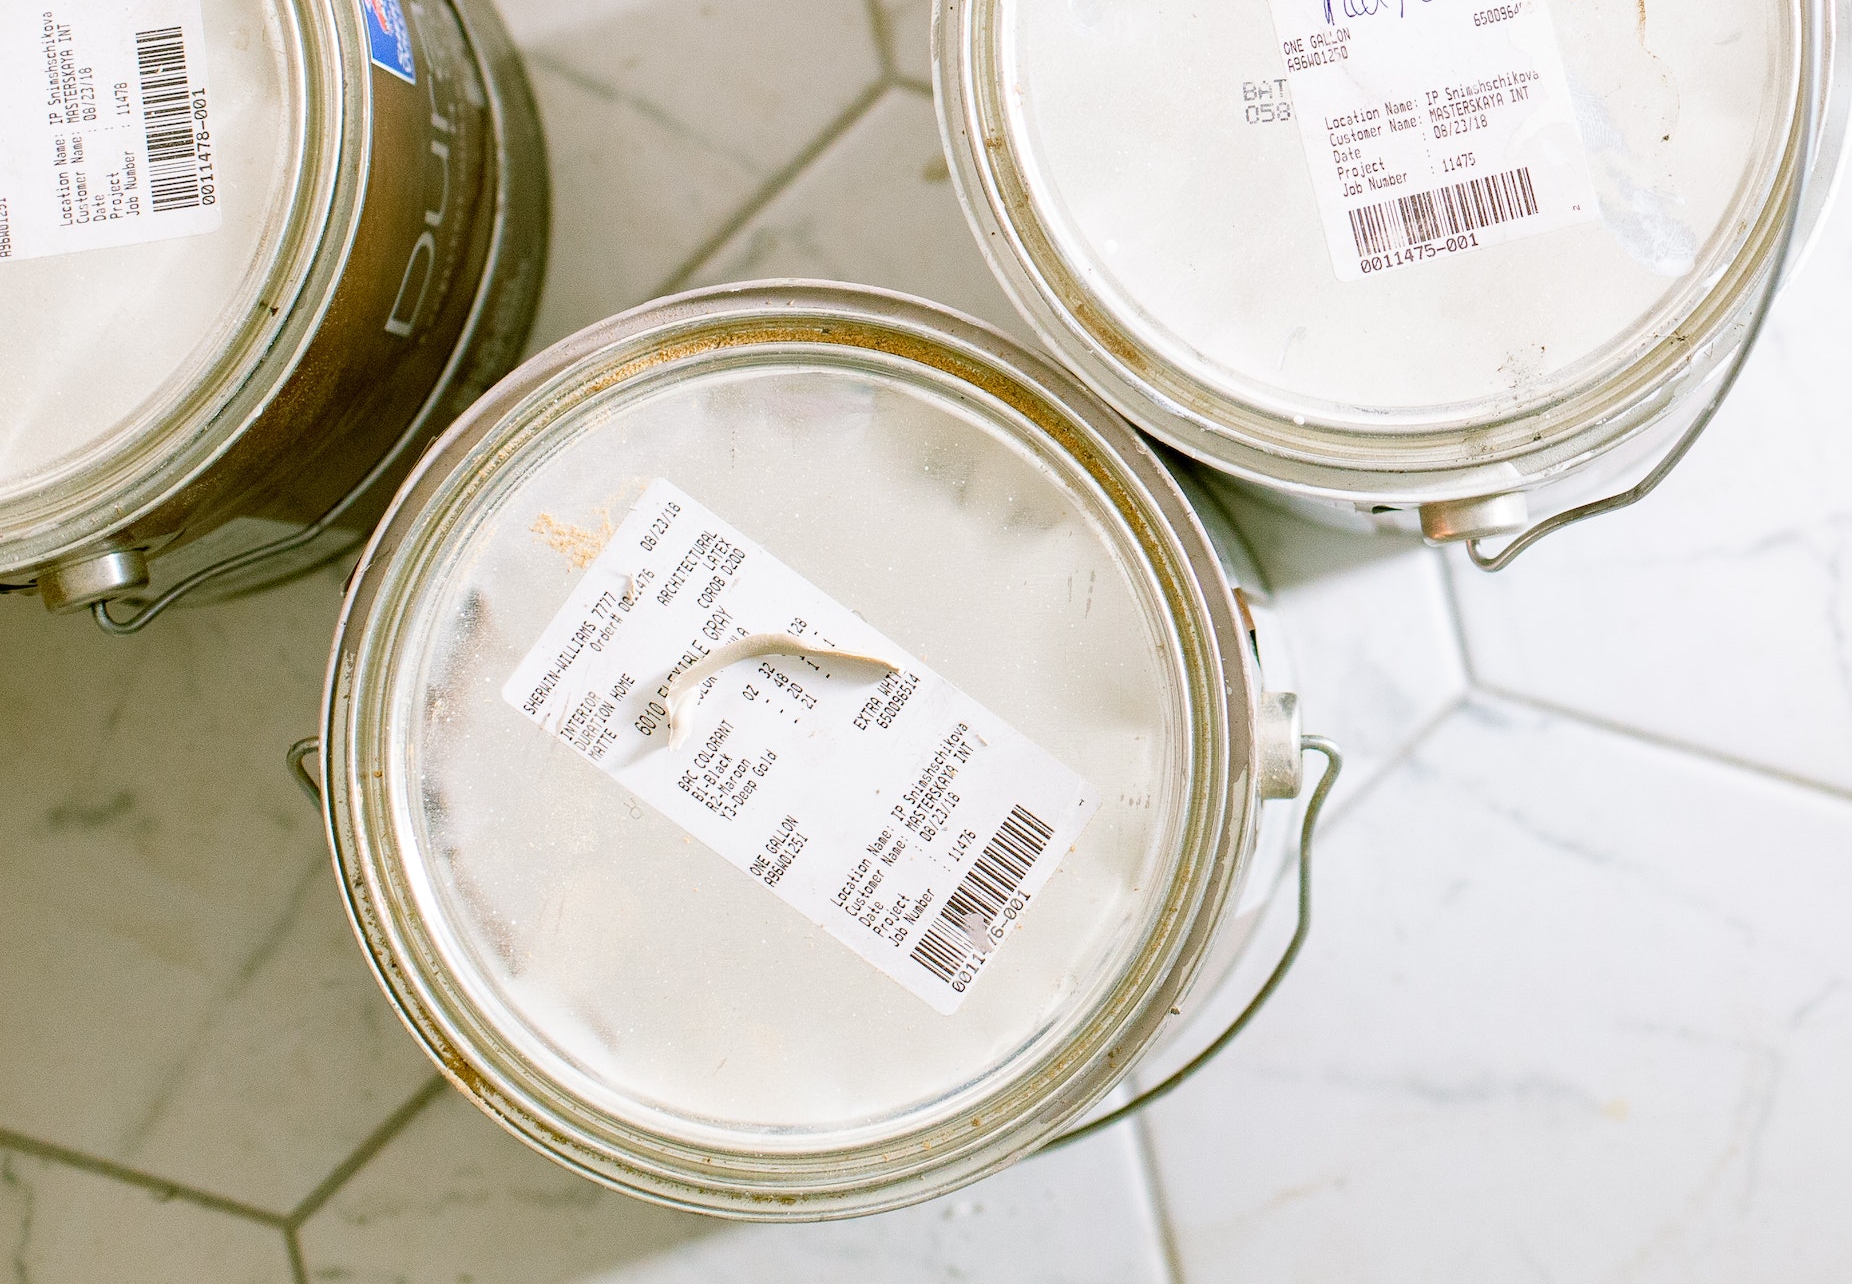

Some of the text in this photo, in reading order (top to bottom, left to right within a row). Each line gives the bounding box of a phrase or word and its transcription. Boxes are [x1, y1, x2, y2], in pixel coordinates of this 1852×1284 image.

[1309, 27, 1351, 49] GALLON
[40, 11, 73, 226] Location Name: IP Snimshschikova
[55, 23, 90, 224] Customer Name: MASTERSKAYA INT
[1324, 70, 1539, 130] Location Name: IP Snimshschikova
[1328, 84, 1528, 147] Customer Name: MASTERSKAYA INT
[78, 66, 107, 222] Date 08/23/18
[113, 81, 140, 216] Job Number 11478
[191, 87, 216, 205] 0011478-001
[1332, 113, 1488, 164] Date 08/23/18
[1336, 157, 1385, 180] Project
[105, 171, 124, 219] Project
[1339, 151, 1476, 199] Job Number 11475
[1359, 231, 1479, 274] 0011475-001
[639, 501, 681, 552] 08/23/18
[706, 537, 731, 571] LATEX
[656, 533, 718, 606] ARCHITECTURAL
[696, 547, 745, 609] COROB D200
[522, 590, 616, 715] SHERWIN-WILLIAMS 7777
[588, 612, 623, 652] Order#
[633, 700, 666, 736] 6010
[701, 607, 732, 641] GRAY
[852, 661, 908, 731] EXTRA WHIT
[875, 673, 920, 729] 650096514
[559, 691, 596, 741] INTERIOR
[573, 672, 635, 751] DURATION HOME
[587, 727, 617, 756] MATTE
[677, 768, 698, 792] BAC
[693, 718, 730, 769] COLORANT
[741, 683, 759, 701] OZ
[757, 661, 776, 679] 32
[690, 670, 790, 802] B1-Black 48
[704, 758, 750, 812] R2-Maroon
[785, 681, 803, 699] 20
[719, 693, 817, 821] Y3-Deep Gold 21
[748, 815, 798, 876] ONE GALLON
[830, 722, 968, 907] Location Name: IP Snimshschikova
[844, 740, 973, 916] Customer Name: MASTERSKAYA INT
[763, 832, 808, 887] A96W01251
[857, 791, 960, 928] Date 08/23/18
[885, 828, 976, 949] Job Number 11476
[871, 894, 910, 937] Project
